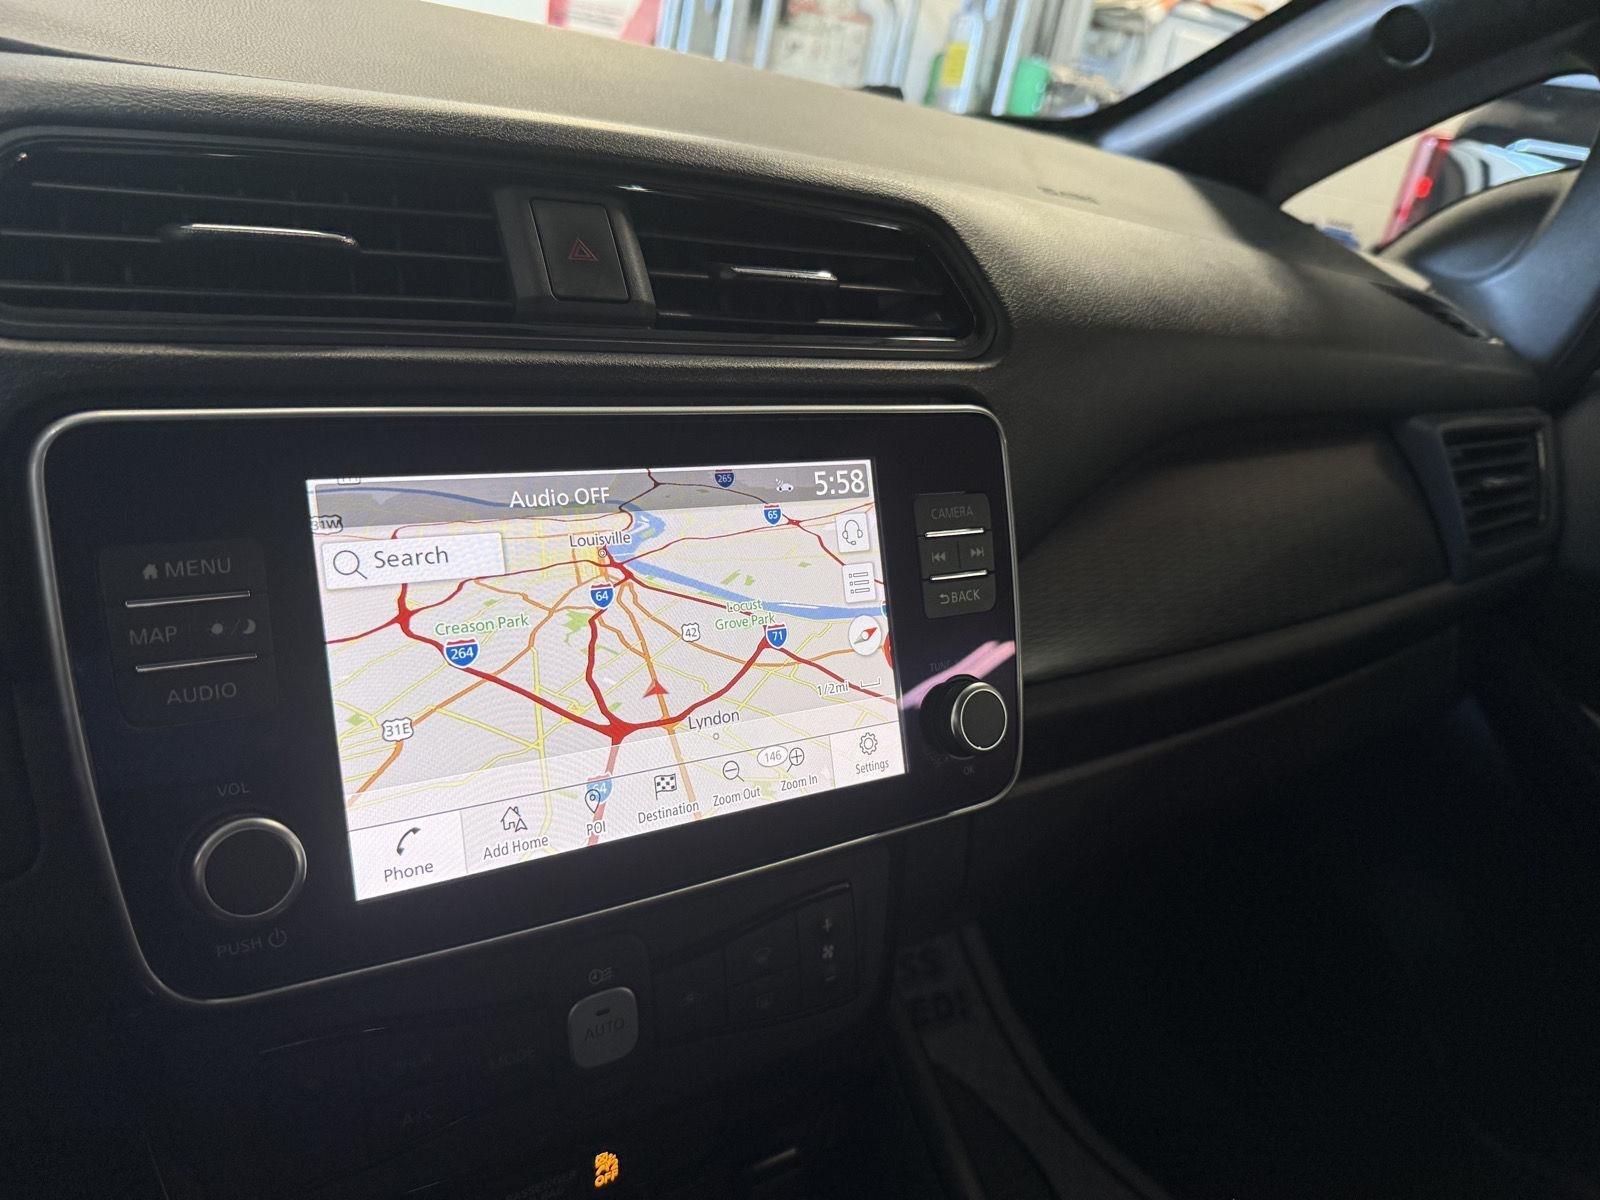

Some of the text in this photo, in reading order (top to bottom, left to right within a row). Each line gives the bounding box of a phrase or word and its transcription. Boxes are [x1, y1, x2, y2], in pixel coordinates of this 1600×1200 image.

[717, 474, 732, 484] 265
[814, 469, 865, 496] 5:58
[509, 486, 611, 509] Audio OFF
[767, 510, 779, 521] 65
[930, 505, 974, 520] CAMERA
[569, 532, 631, 548] Louisville
[373, 546, 449, 569] Search
[164, 556, 232, 579] MENU
[595, 589, 609, 602] 64
[951, 588, 981, 604] BACK
[726, 599, 762, 613] Locust
[434, 613, 530, 637] Creason Park
[714, 612, 776, 631] Grove Park
[129, 625, 178, 646] MAP
[685, 626, 698, 639] 42
[771, 629, 784, 642] 71
[451, 647, 474, 660] 264
[166, 681, 238, 706] AUDIO
[816, 681, 850, 696] 1/2mi
[687, 710, 740, 730] Lyndon
[385, 724, 411, 738] 31E
[763, 749, 783, 763] 146
[855, 758, 890, 776] Settings
[216, 781, 250, 797] VOL
[780, 773, 818, 792] Zoom In
[713, 786, 761, 808] Zoom Out
[637, 800, 700, 825] Destination
[586, 820, 607, 836] POI
[483, 835, 550, 861] Add Home
[383, 861, 434, 882] Phone
[216, 936, 262, 958] PUSH
[584, 1018, 625, 1042] AUTO
